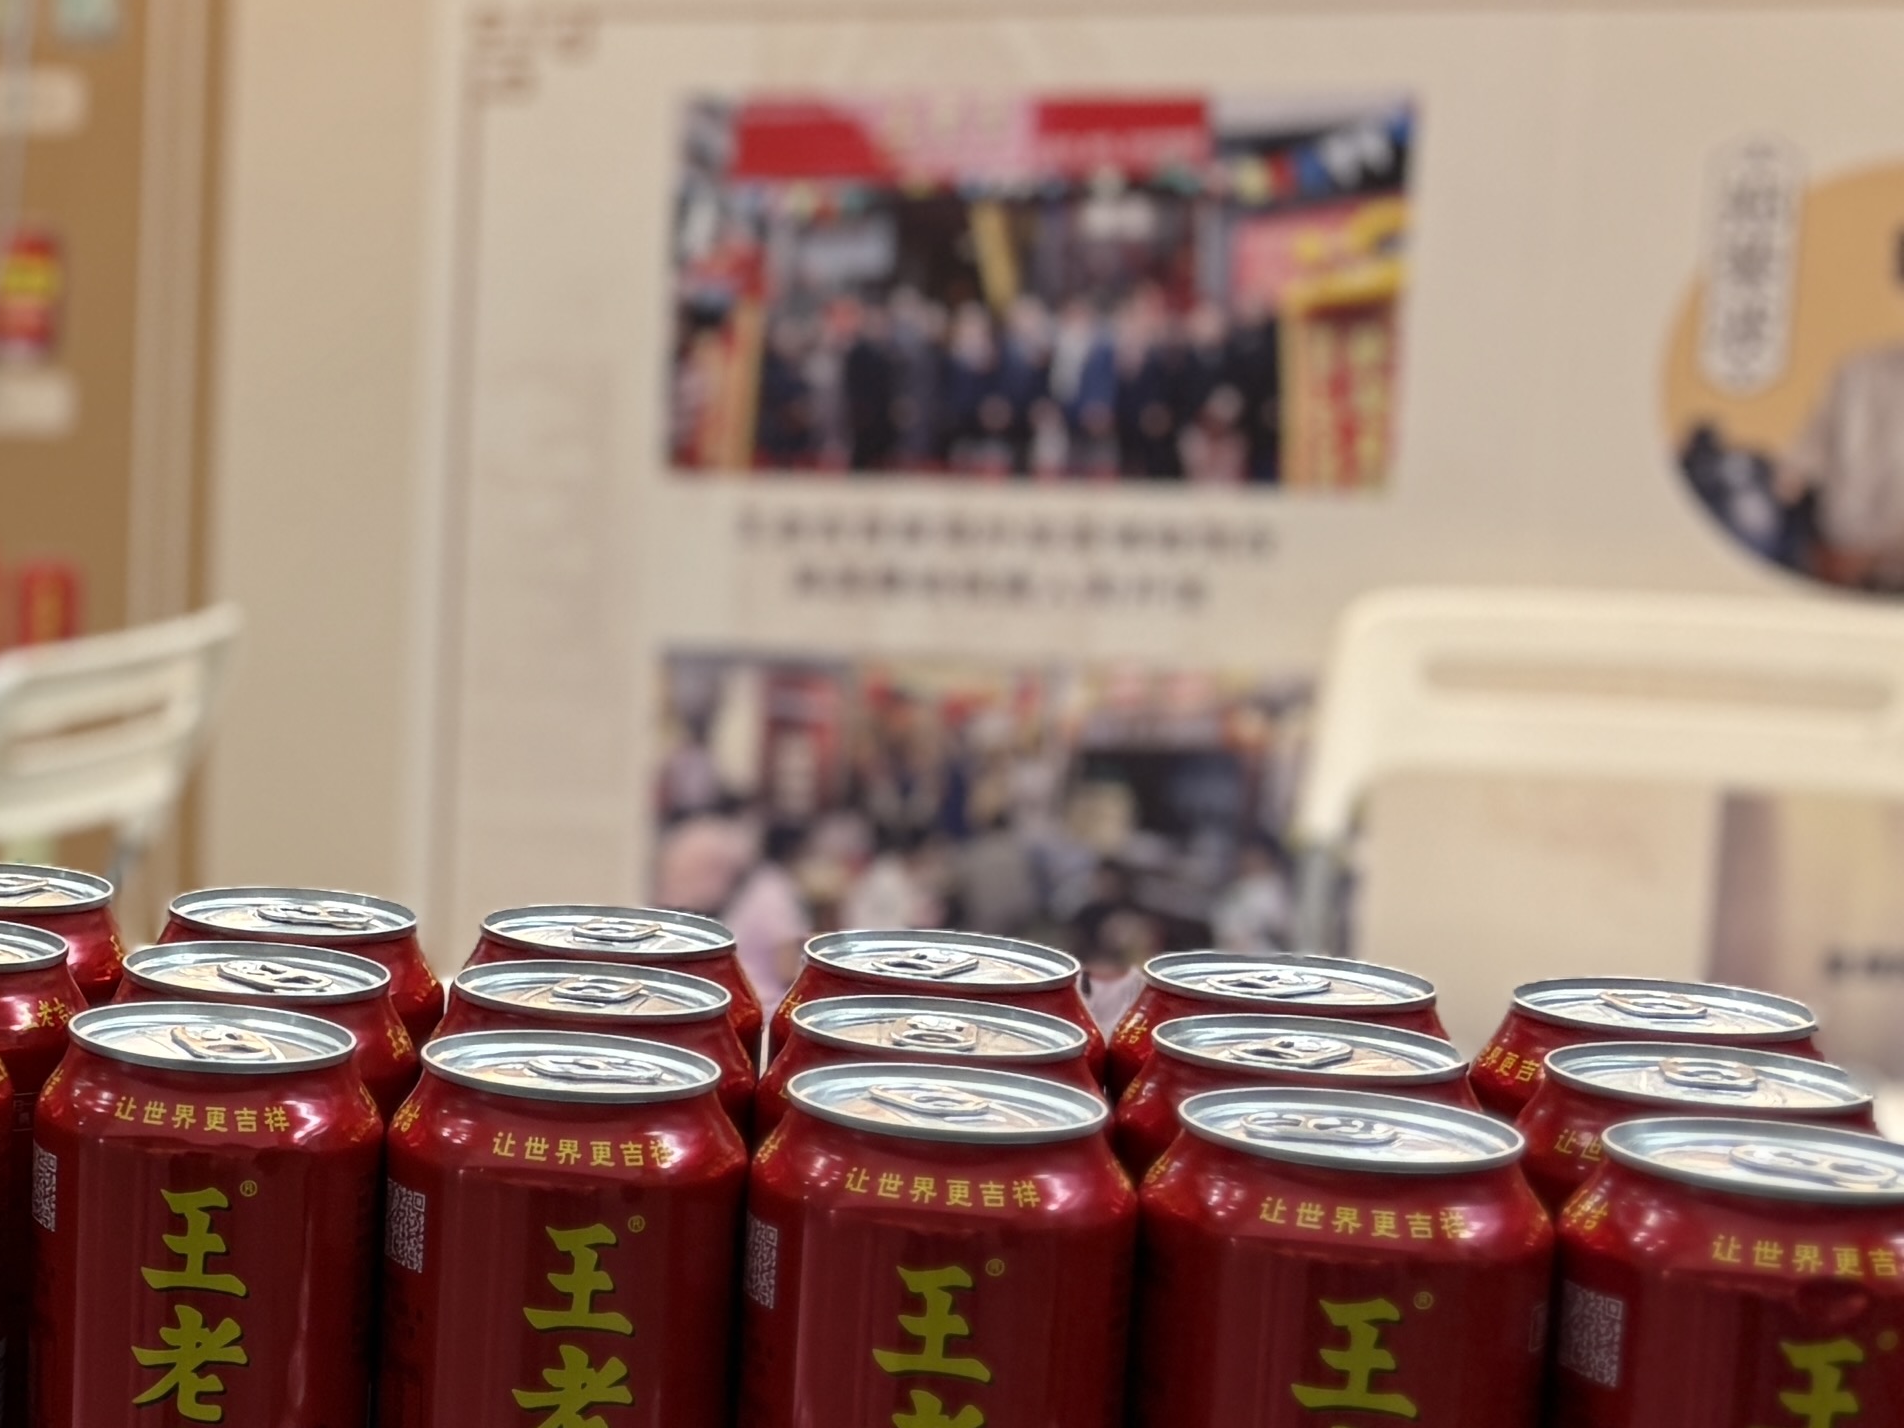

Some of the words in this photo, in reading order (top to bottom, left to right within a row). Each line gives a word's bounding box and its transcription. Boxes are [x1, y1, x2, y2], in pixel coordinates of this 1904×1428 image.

[114, 1096, 291, 1133] 让世界更吉祥
[492, 1132, 674, 1168] 让世界更吉祥
[844, 1167, 1042, 1209] 让世界更吉祥
[1259, 1197, 1470, 1239] 让世界更吉祥
